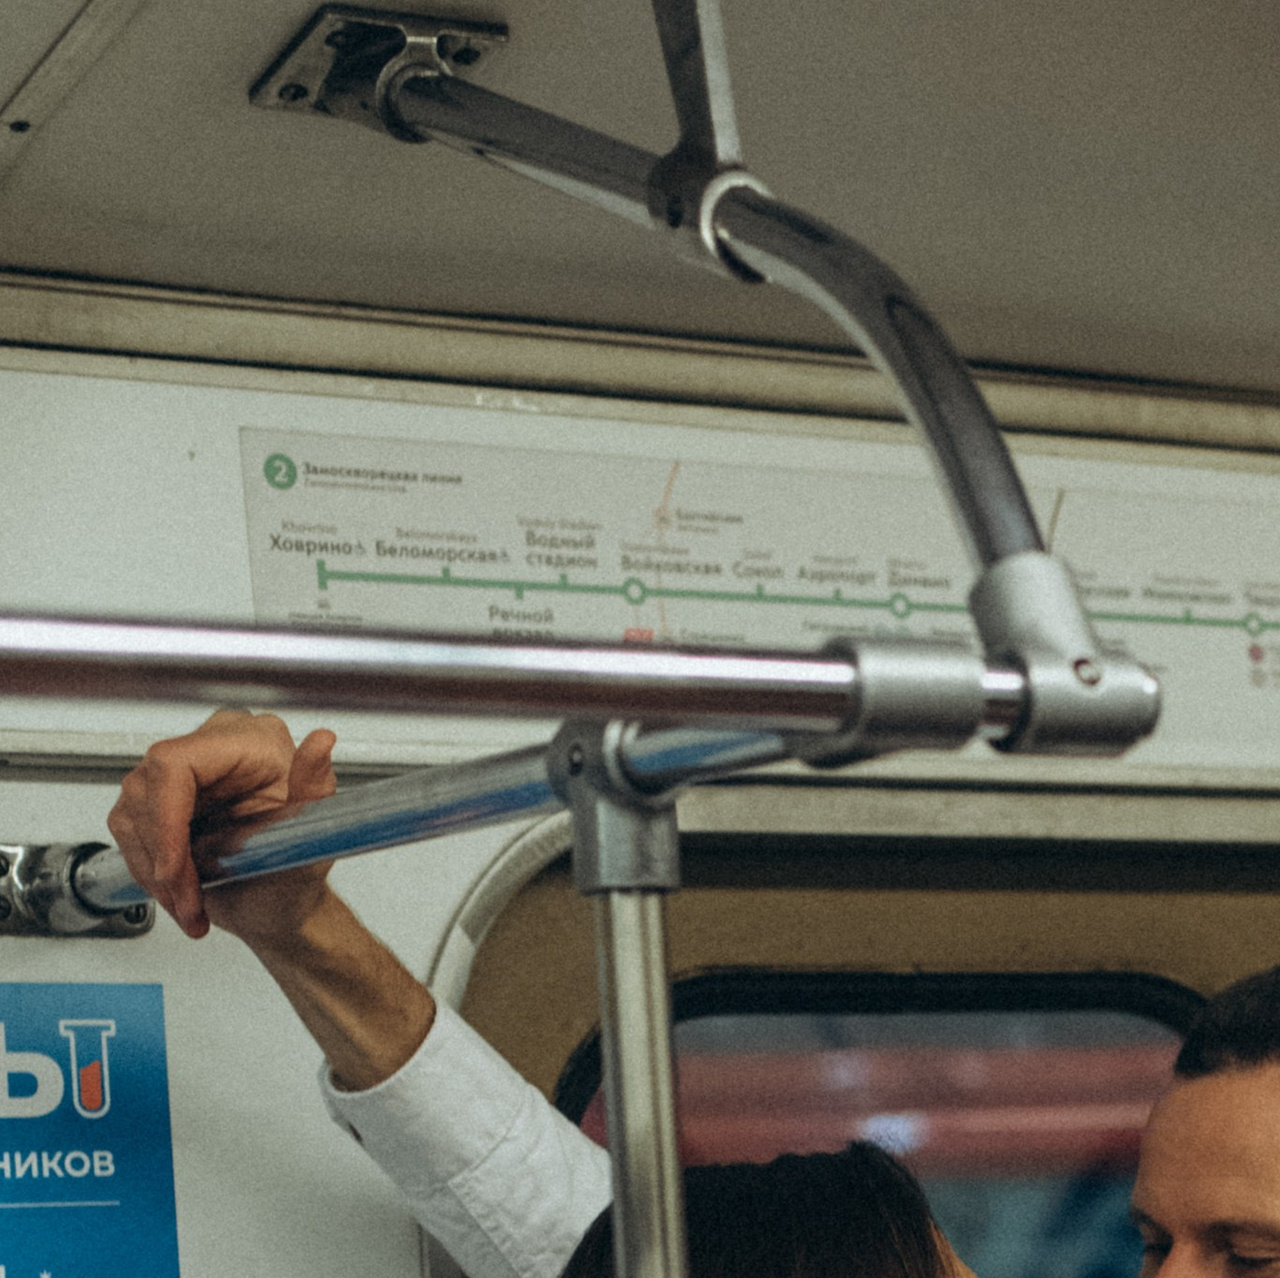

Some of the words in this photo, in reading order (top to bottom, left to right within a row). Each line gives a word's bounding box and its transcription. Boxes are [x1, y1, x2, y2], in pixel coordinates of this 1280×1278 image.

[269, 534, 353, 556] Ховрино
[525, 531, 595, 551] Водный
[375, 541, 498, 564] Беломорская
[526, 551, 599, 570] стадион
[620, 553, 723, 577] Войковская
[488, 604, 554, 624] Речной
